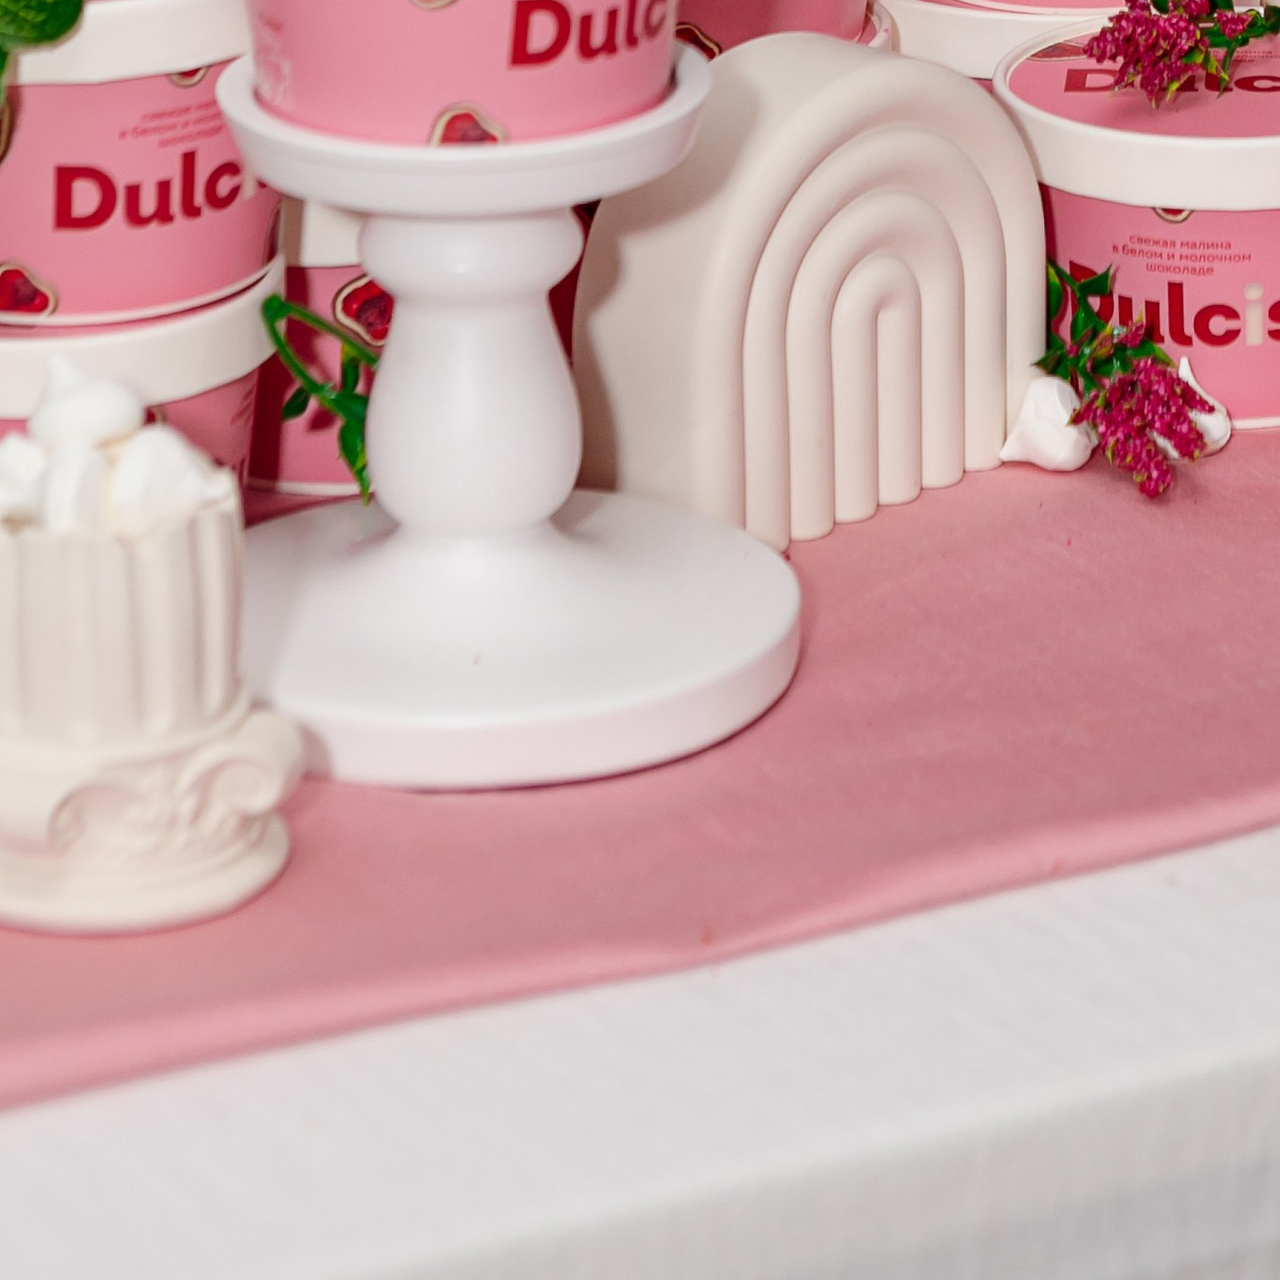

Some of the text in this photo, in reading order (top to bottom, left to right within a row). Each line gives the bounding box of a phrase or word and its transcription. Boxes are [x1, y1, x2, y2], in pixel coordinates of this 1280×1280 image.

[53, 150, 252, 231] Dulc
[1129, 235, 1232, 251] свежая малина
[1112, 244, 1252, 263] в белом и молочном
[1146, 263, 1214, 276] шоколаде
